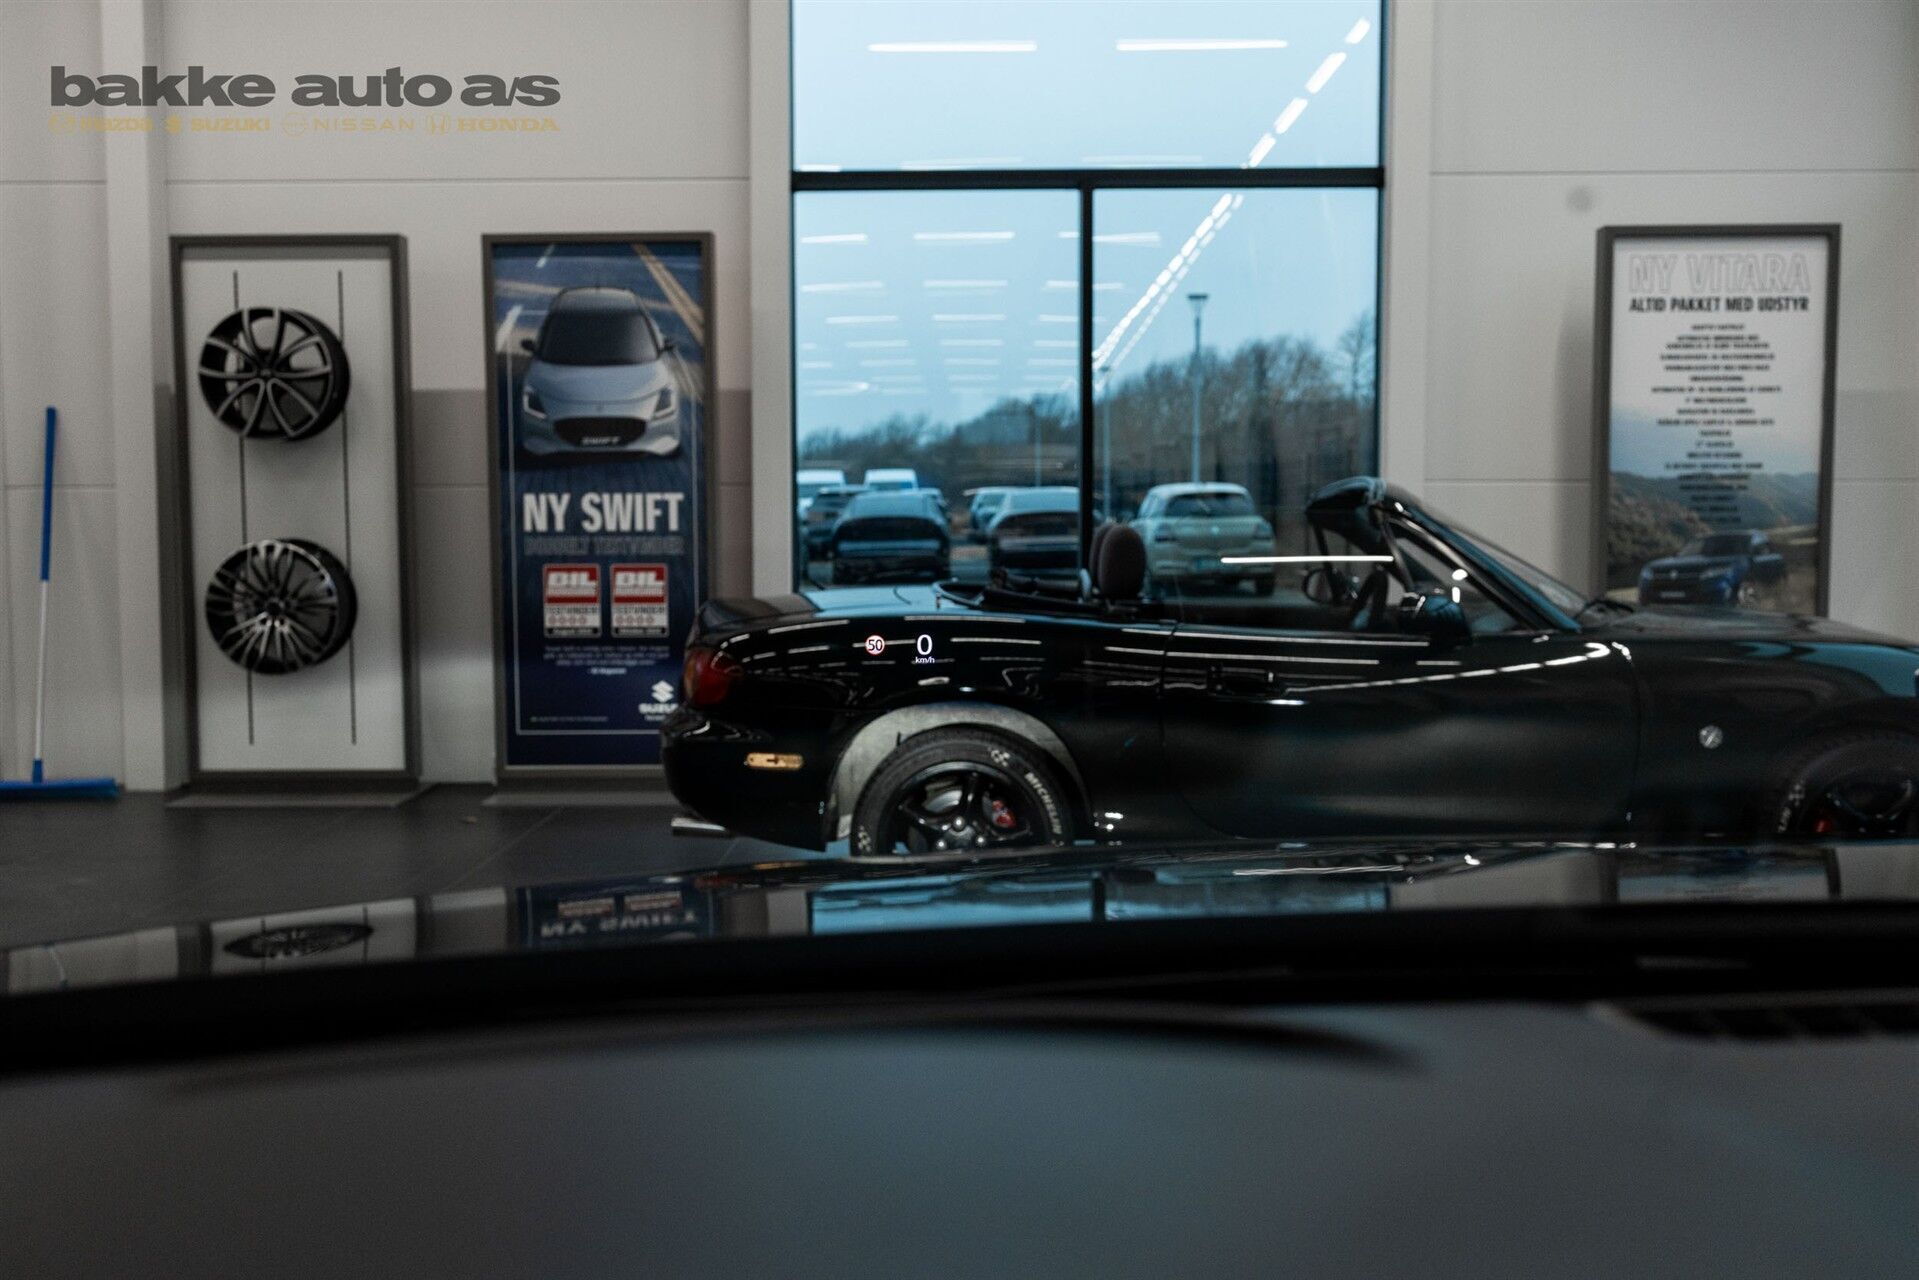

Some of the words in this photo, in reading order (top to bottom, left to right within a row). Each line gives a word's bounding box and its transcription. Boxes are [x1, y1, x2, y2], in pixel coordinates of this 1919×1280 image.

[1629, 254, 1677, 294] NY
[1686, 252, 1811, 293] VITARA
[1629, 297, 1666, 312] ALTID
[1670, 297, 1720, 312] PAKKET
[1727, 297, 1754, 311] MED
[1758, 296, 1809, 311] UDSTYR
[523, 492, 570, 533] NY
[582, 492, 684, 533] SWIFT
[867, 639, 883, 652] 50
[916, 634, 933, 655] 0
[915, 656, 935, 664] km/h
